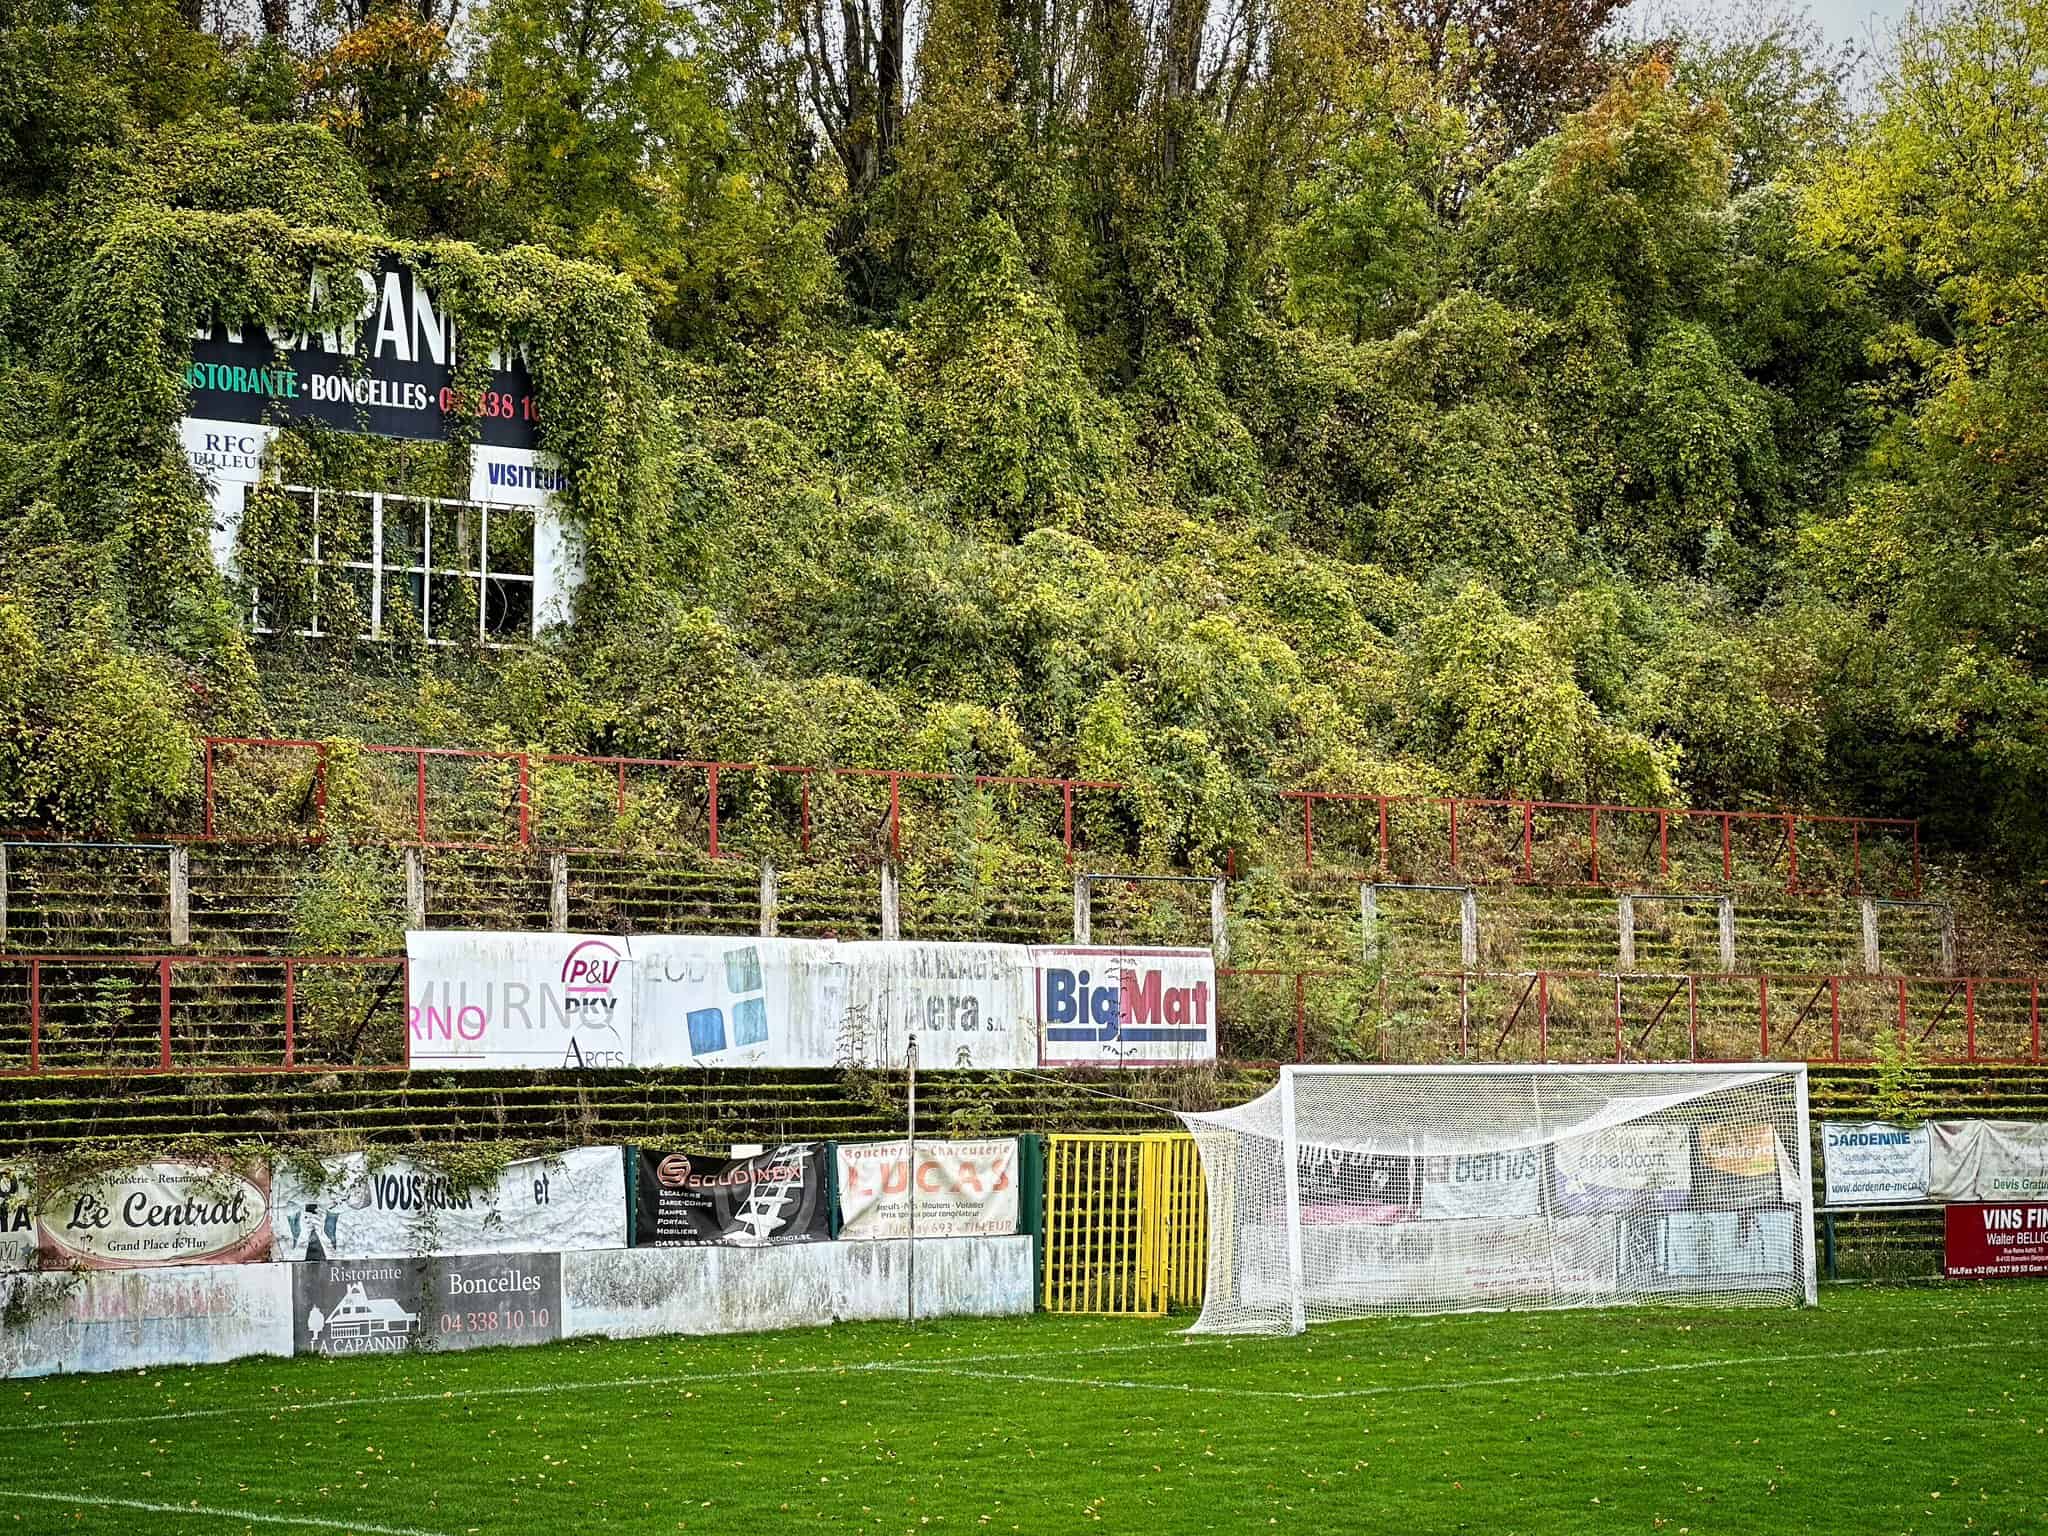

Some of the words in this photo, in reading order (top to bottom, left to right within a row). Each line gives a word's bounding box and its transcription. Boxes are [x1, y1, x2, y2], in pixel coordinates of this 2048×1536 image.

[311, 373, 428, 410] BONCELLES
[205, 433, 256, 455] RFC
[193, 451, 263, 469] TILLEU
[569, 959, 620, 984] P&V
[1046, 967, 1210, 1040] BigMat
[1828, 1132, 1911, 1147] DARDENNE
[848, 1159, 1009, 1196] LUCAS
[1993, 1178, 2019, 1190] Devis
[374, 1173, 423, 1211] VOUS
[66, 1193, 112, 1230] Le
[123, 1189, 246, 1228] Central
[1983, 1208, 2023, 1230] VINS
[107, 1240, 141, 1252] Grand
[143, 1239, 169, 1250] Place
[329, 1266, 402, 1282] Ristorante
[447, 1269, 541, 1295] Boncelles
[440, 1313, 464, 1334] 04
[467, 1311, 499, 1332] 338
[505, 1310, 524, 1329] 10
[530, 1308, 550, 1328] 10
